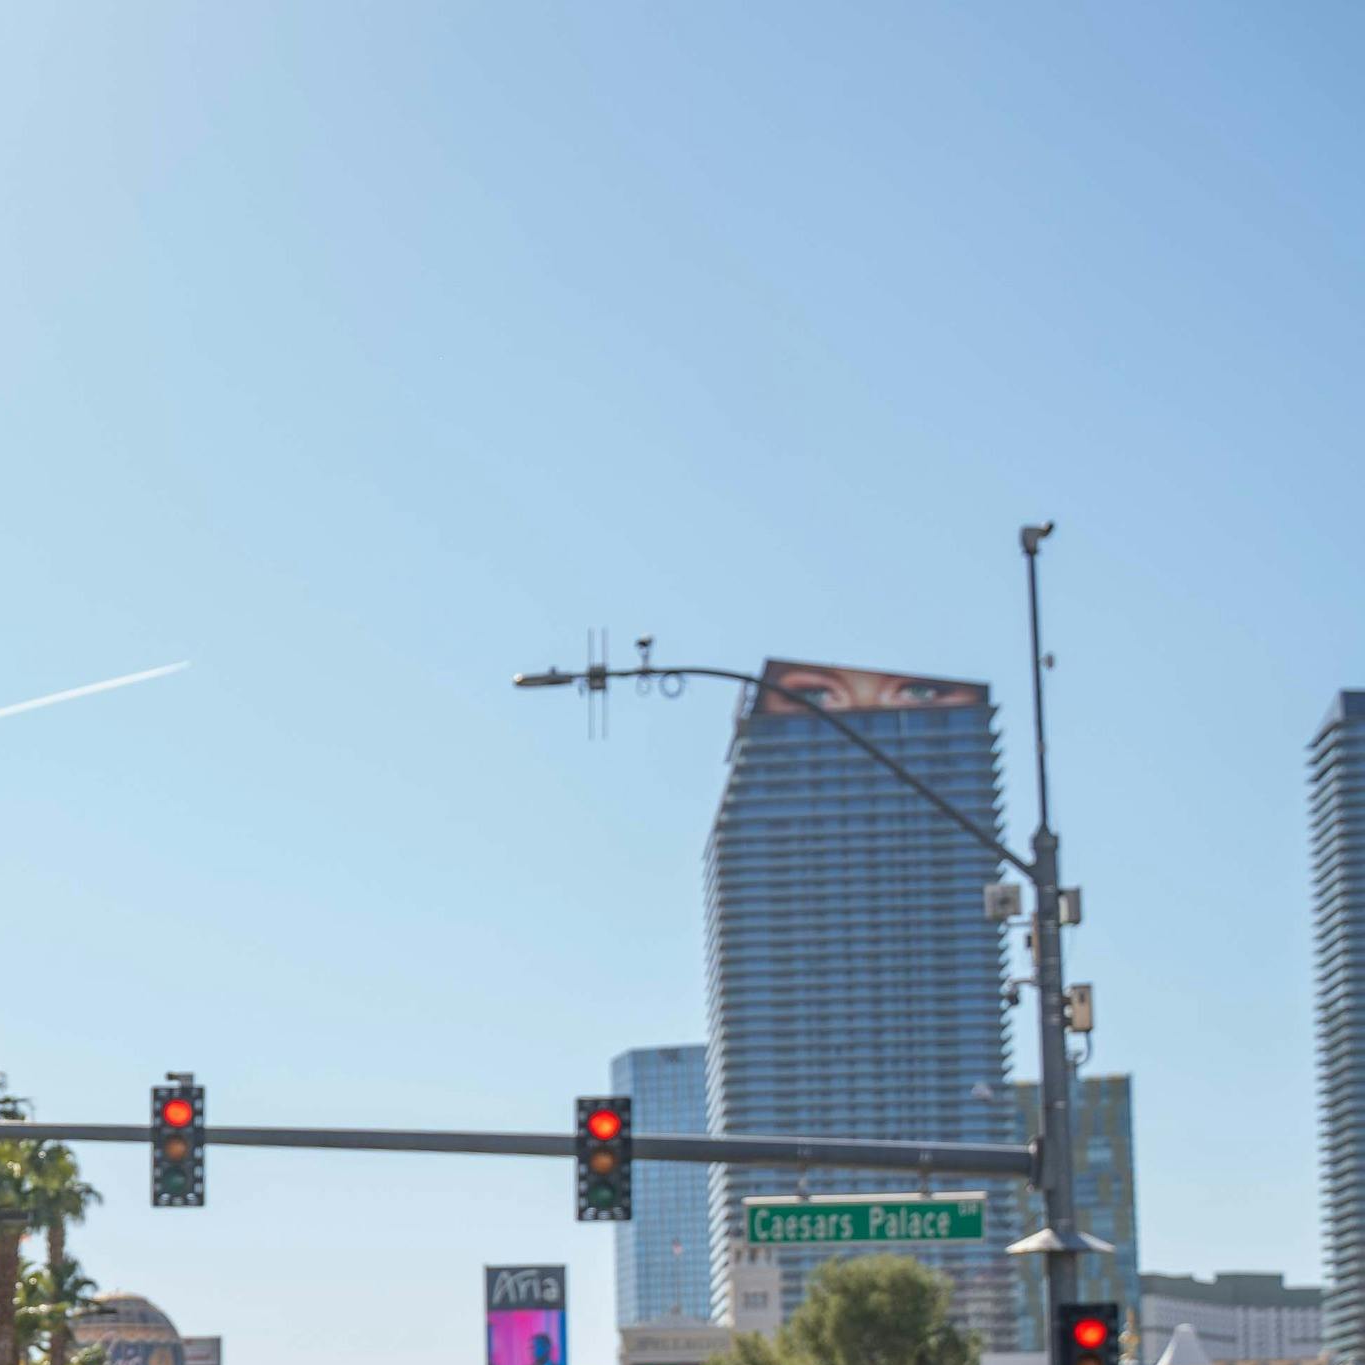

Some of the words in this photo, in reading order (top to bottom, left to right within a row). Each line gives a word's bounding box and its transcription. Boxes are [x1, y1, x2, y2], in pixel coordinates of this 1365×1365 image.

[753, 1208, 854, 1240] Caesars
[869, 1206, 952, 1238] Palace
[491, 1268, 562, 1305] Aria
